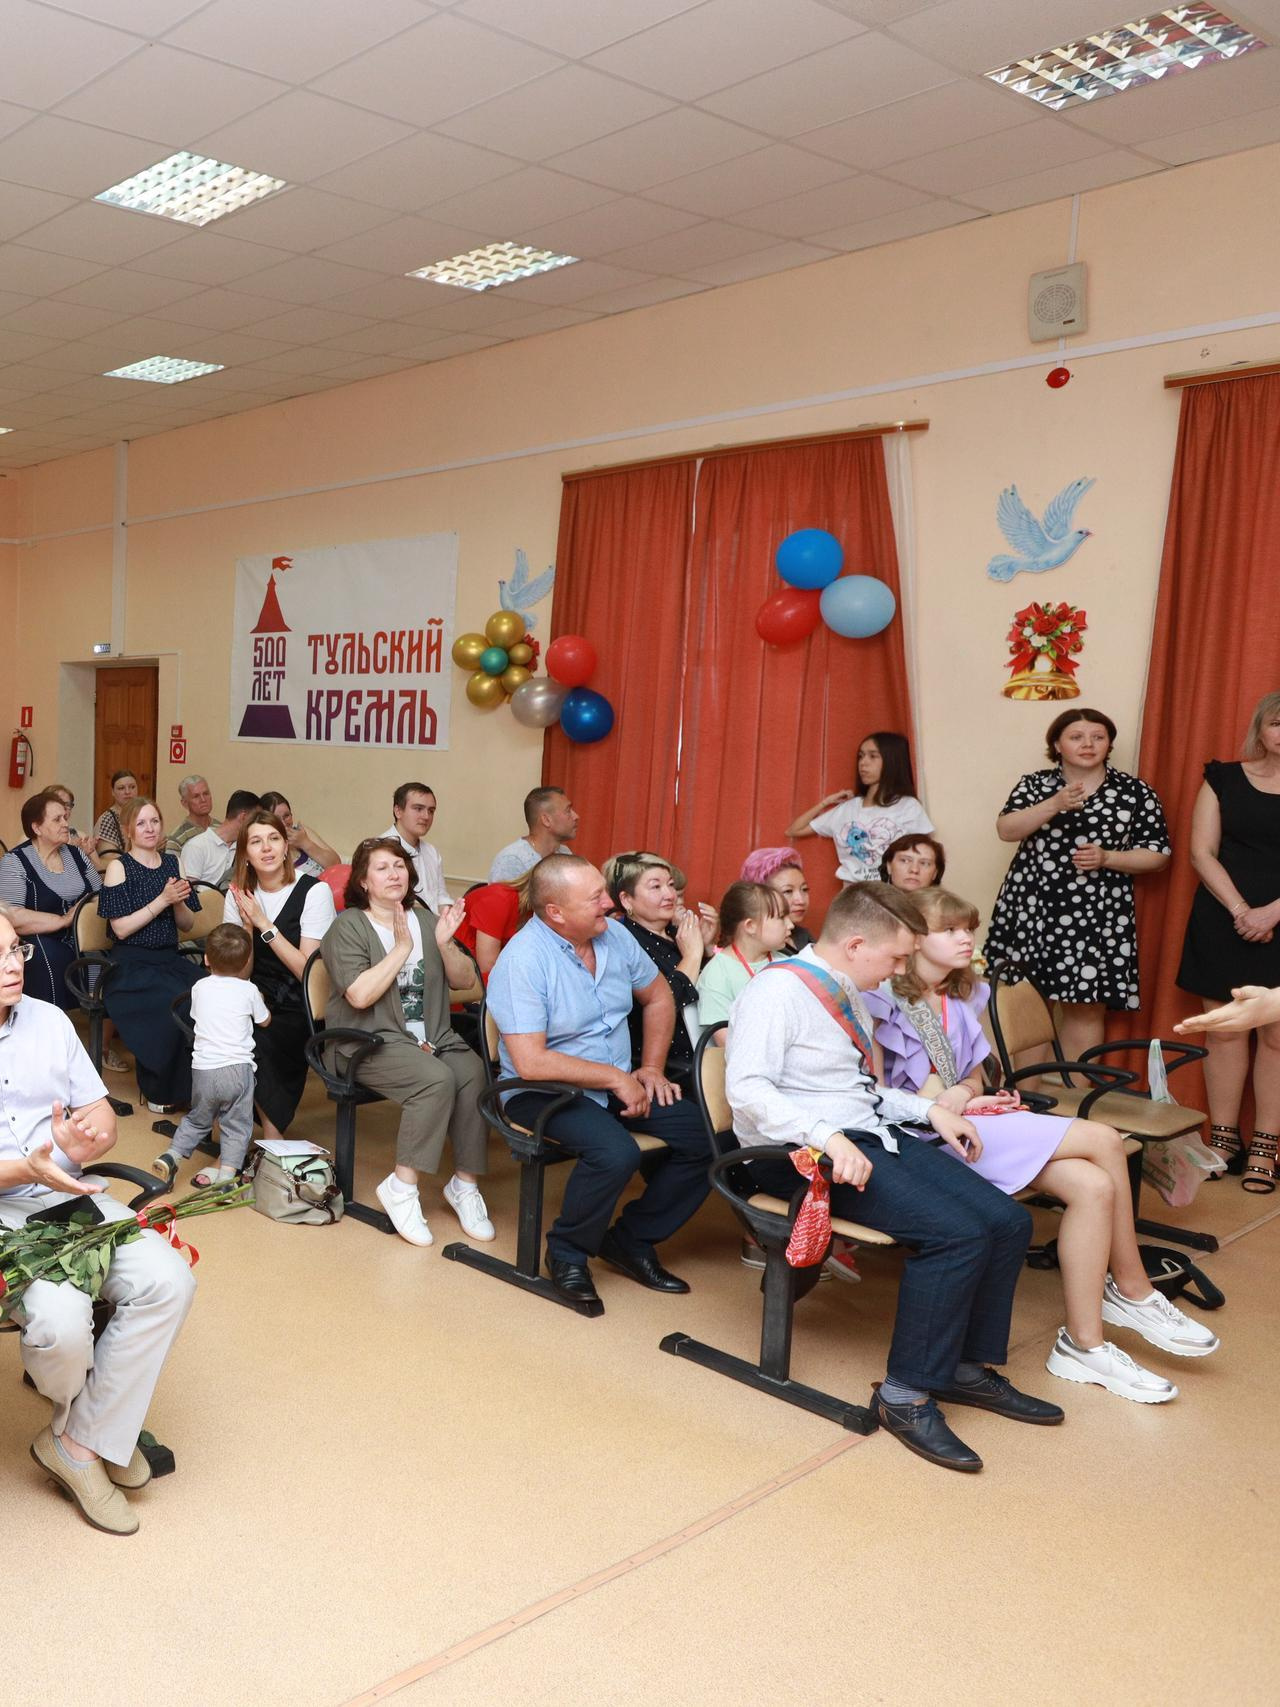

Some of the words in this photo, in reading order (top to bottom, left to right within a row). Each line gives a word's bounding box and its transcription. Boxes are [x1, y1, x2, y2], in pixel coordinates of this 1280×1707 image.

[253, 636, 287, 668] 500
[308, 618, 444, 675] ТУЛЬСКИЙ
[252, 671, 286, 701] ЛЕТ
[305, 690, 438, 745] КРЕМЛЬ
